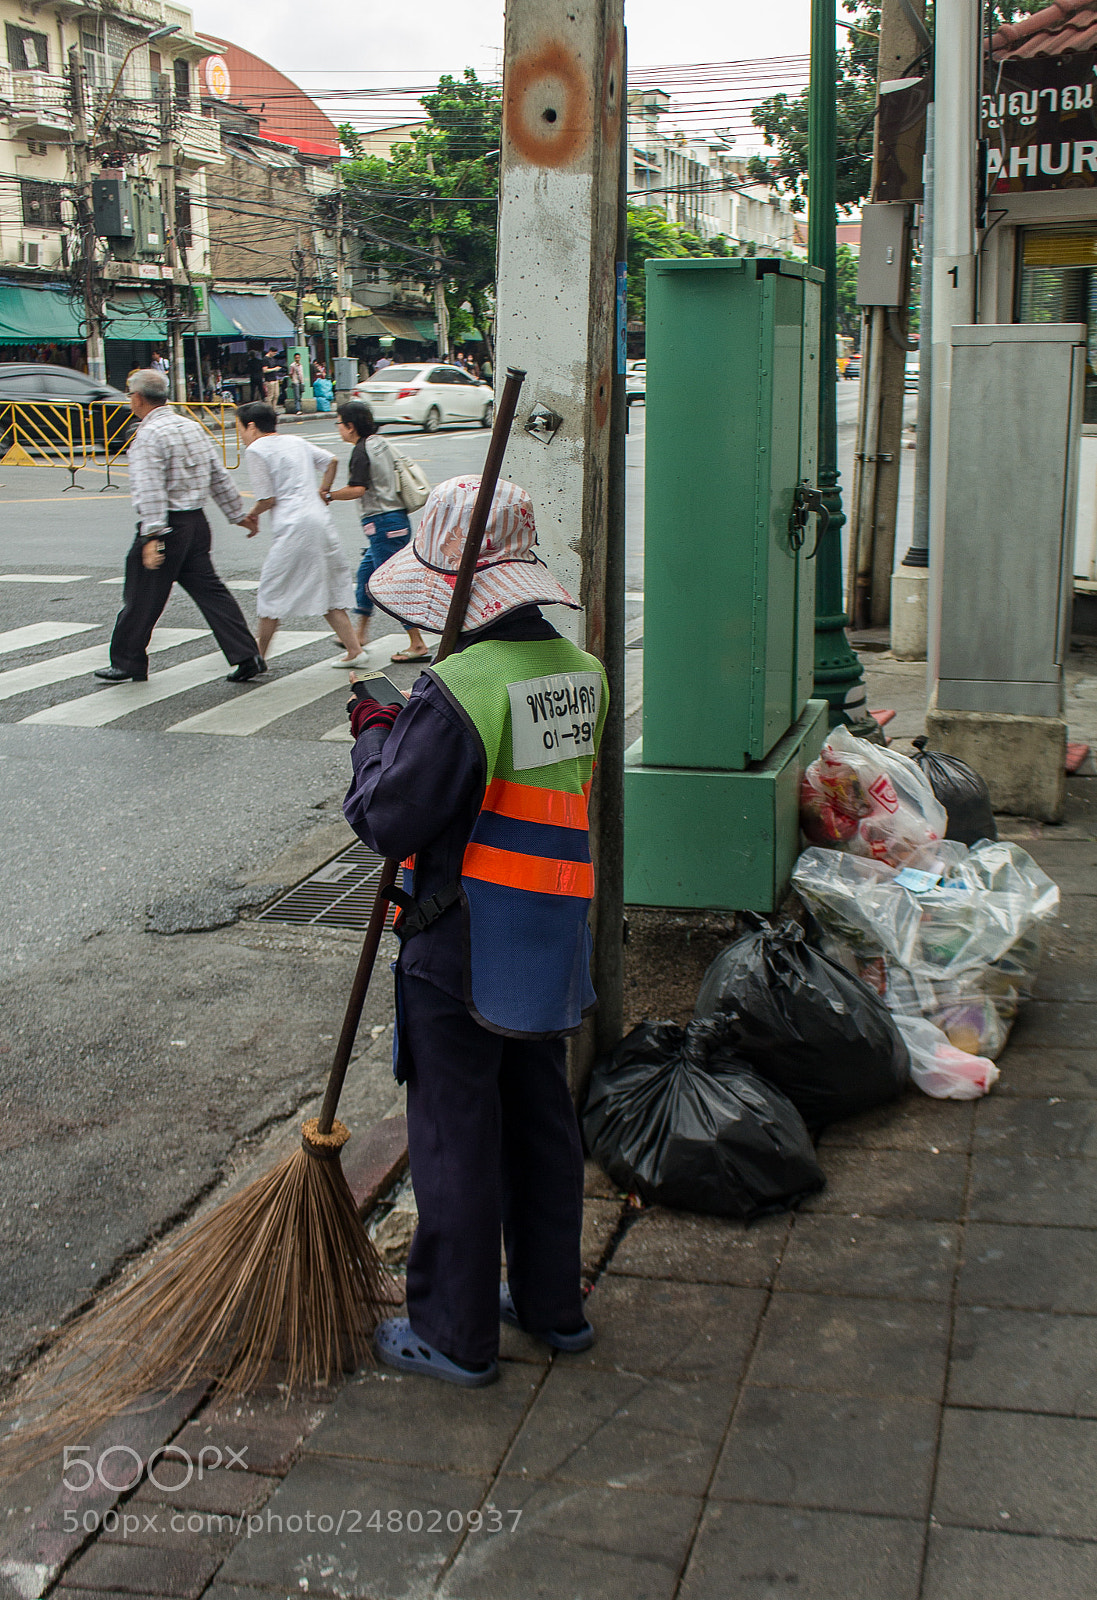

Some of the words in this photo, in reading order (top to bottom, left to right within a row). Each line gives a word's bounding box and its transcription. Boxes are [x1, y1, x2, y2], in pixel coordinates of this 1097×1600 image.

[987, 140, 1097, 179] AHUR
[947, 265, 958, 289] 1
[526, 685, 596, 724] พระนคร
[543, 721, 595, 750] 01-29
